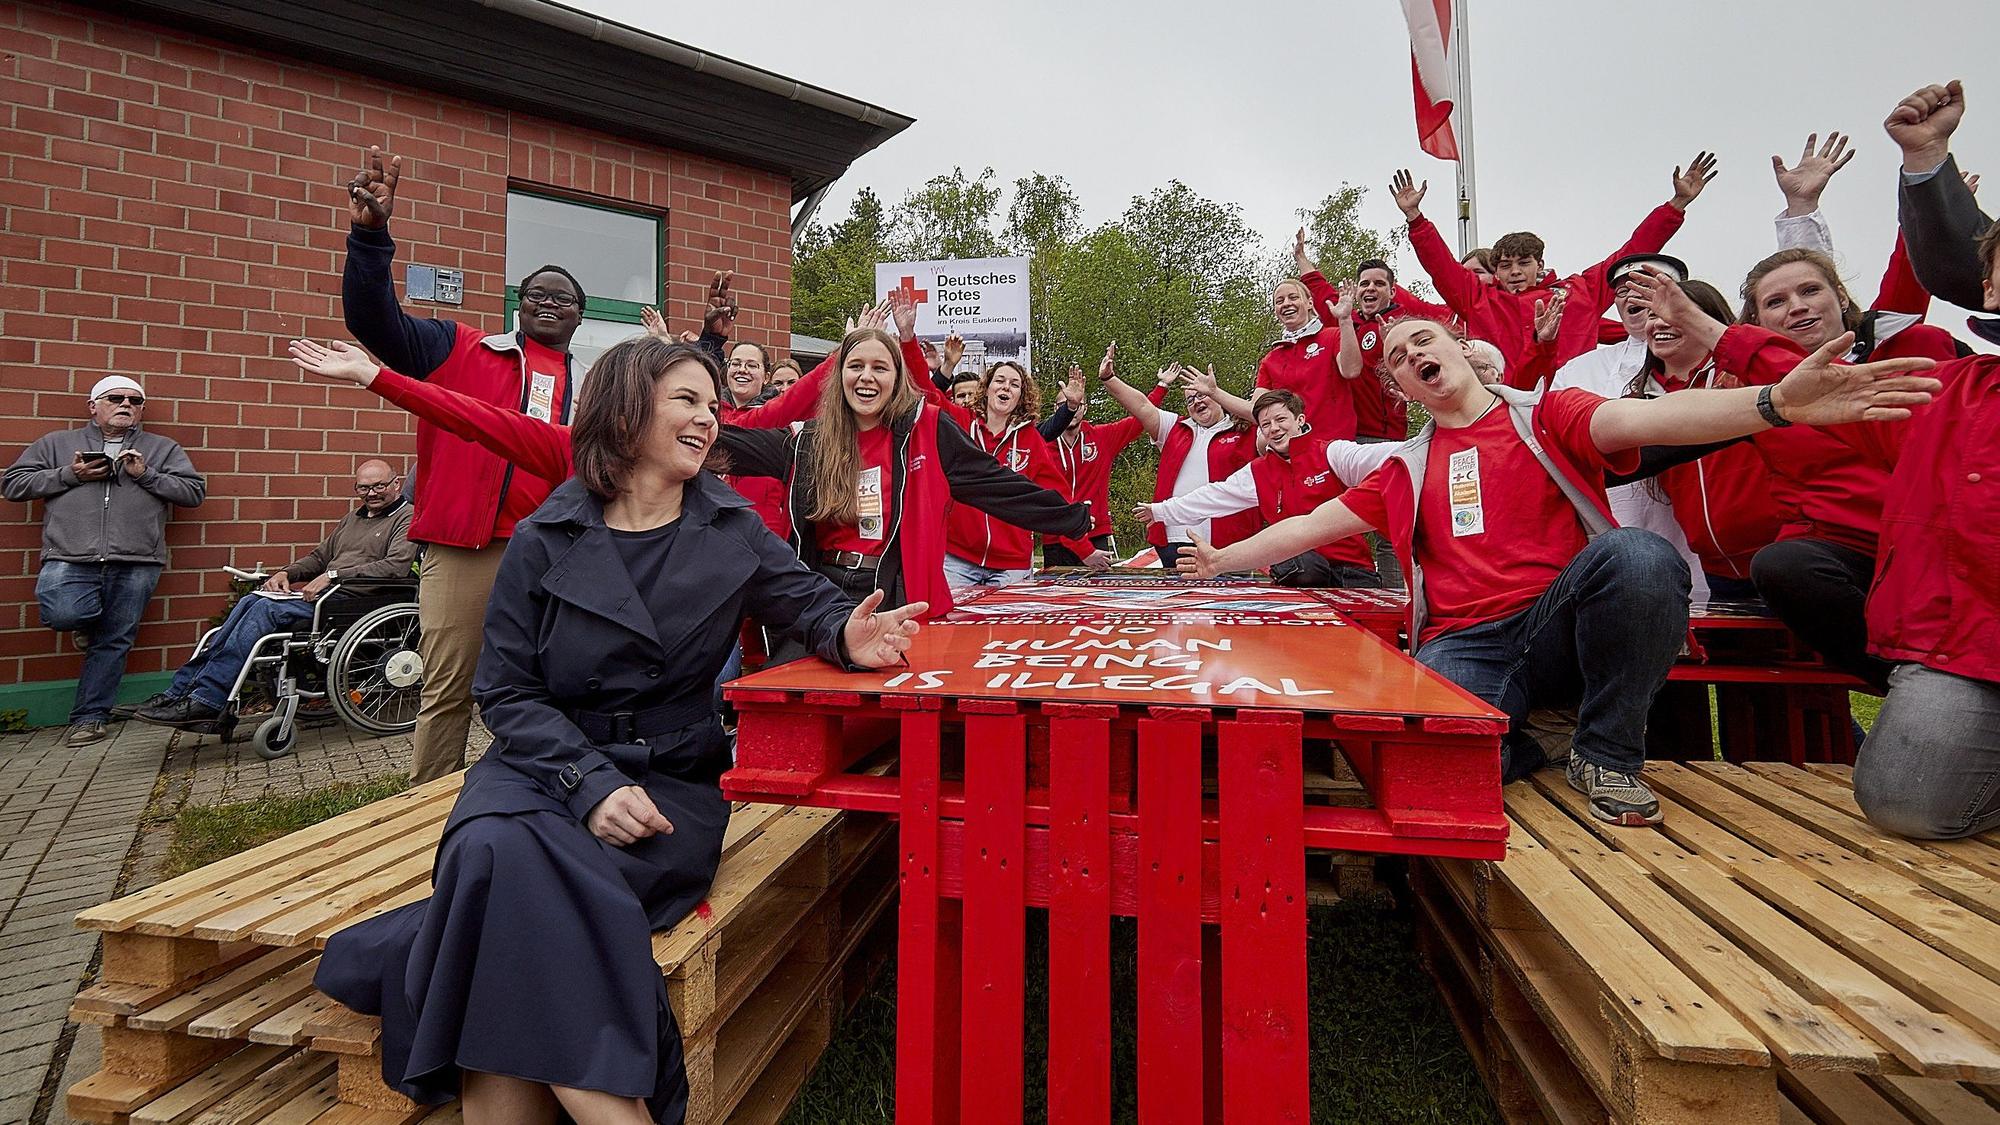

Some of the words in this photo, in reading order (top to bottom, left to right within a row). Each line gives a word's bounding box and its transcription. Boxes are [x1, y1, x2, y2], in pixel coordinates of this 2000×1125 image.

[937, 272, 1017, 287] Deutsches
[937, 289, 981, 302] Rotes
[937, 304, 981, 317] Kreuz
[1069, 625, 1156, 636] NO
[982, 638, 1232, 651] HUMAN
[973, 653, 1205, 669] BEING
[883, 670, 953, 688] IS
[986, 672, 1335, 696] ILLEGAL
